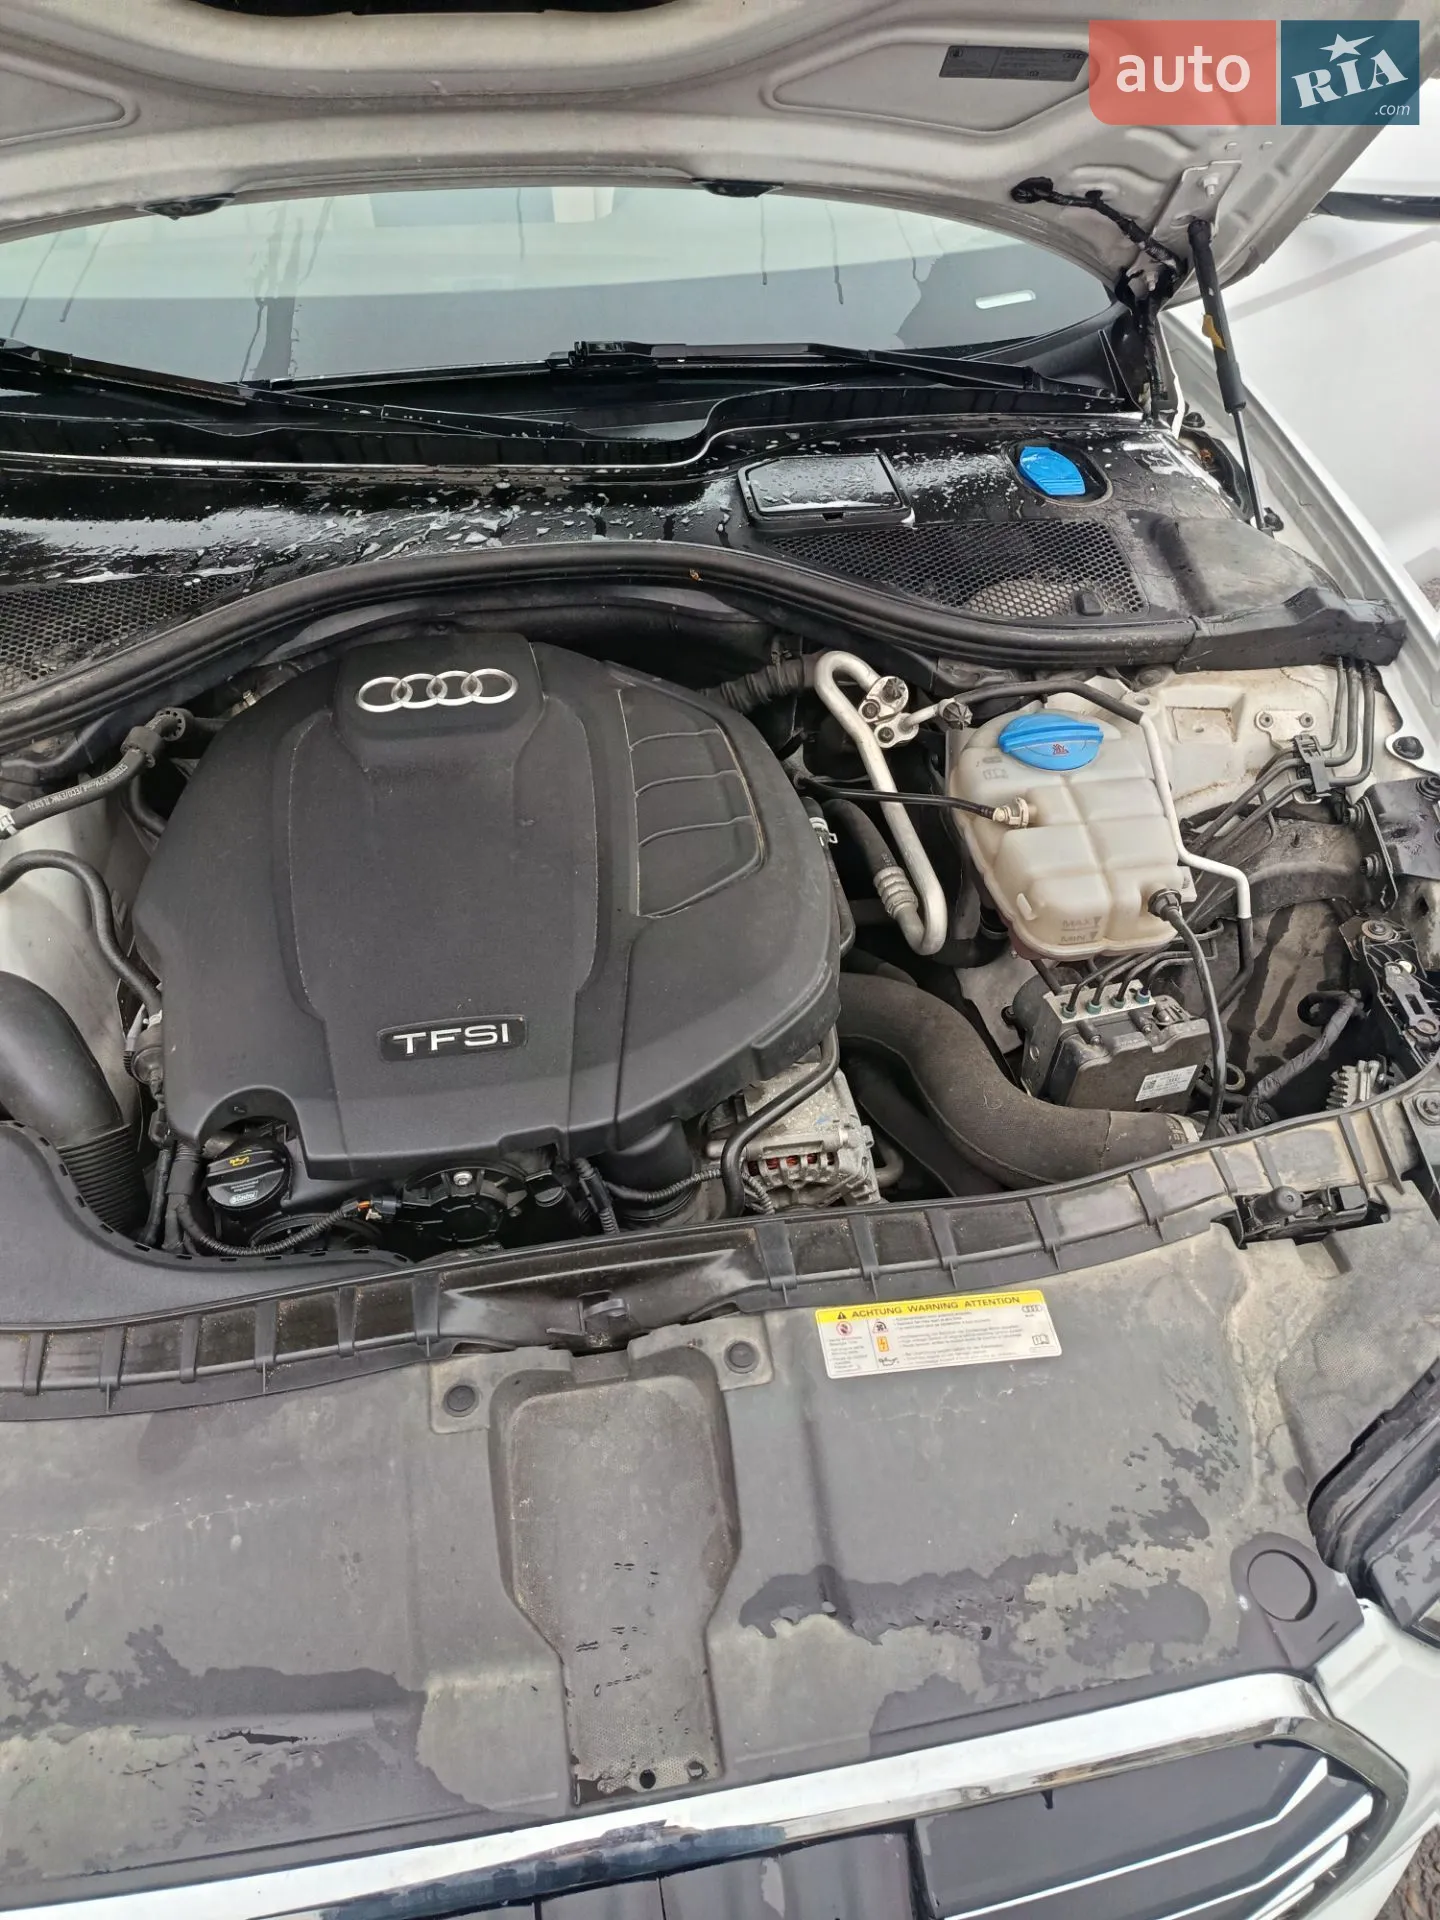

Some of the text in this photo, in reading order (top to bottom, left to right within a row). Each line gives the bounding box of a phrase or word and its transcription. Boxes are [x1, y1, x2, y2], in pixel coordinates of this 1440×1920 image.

[392, 1022, 509, 1055] TFSI
[851, 1296, 1020, 1318] ACHTUNG WARNING ATTENTION
